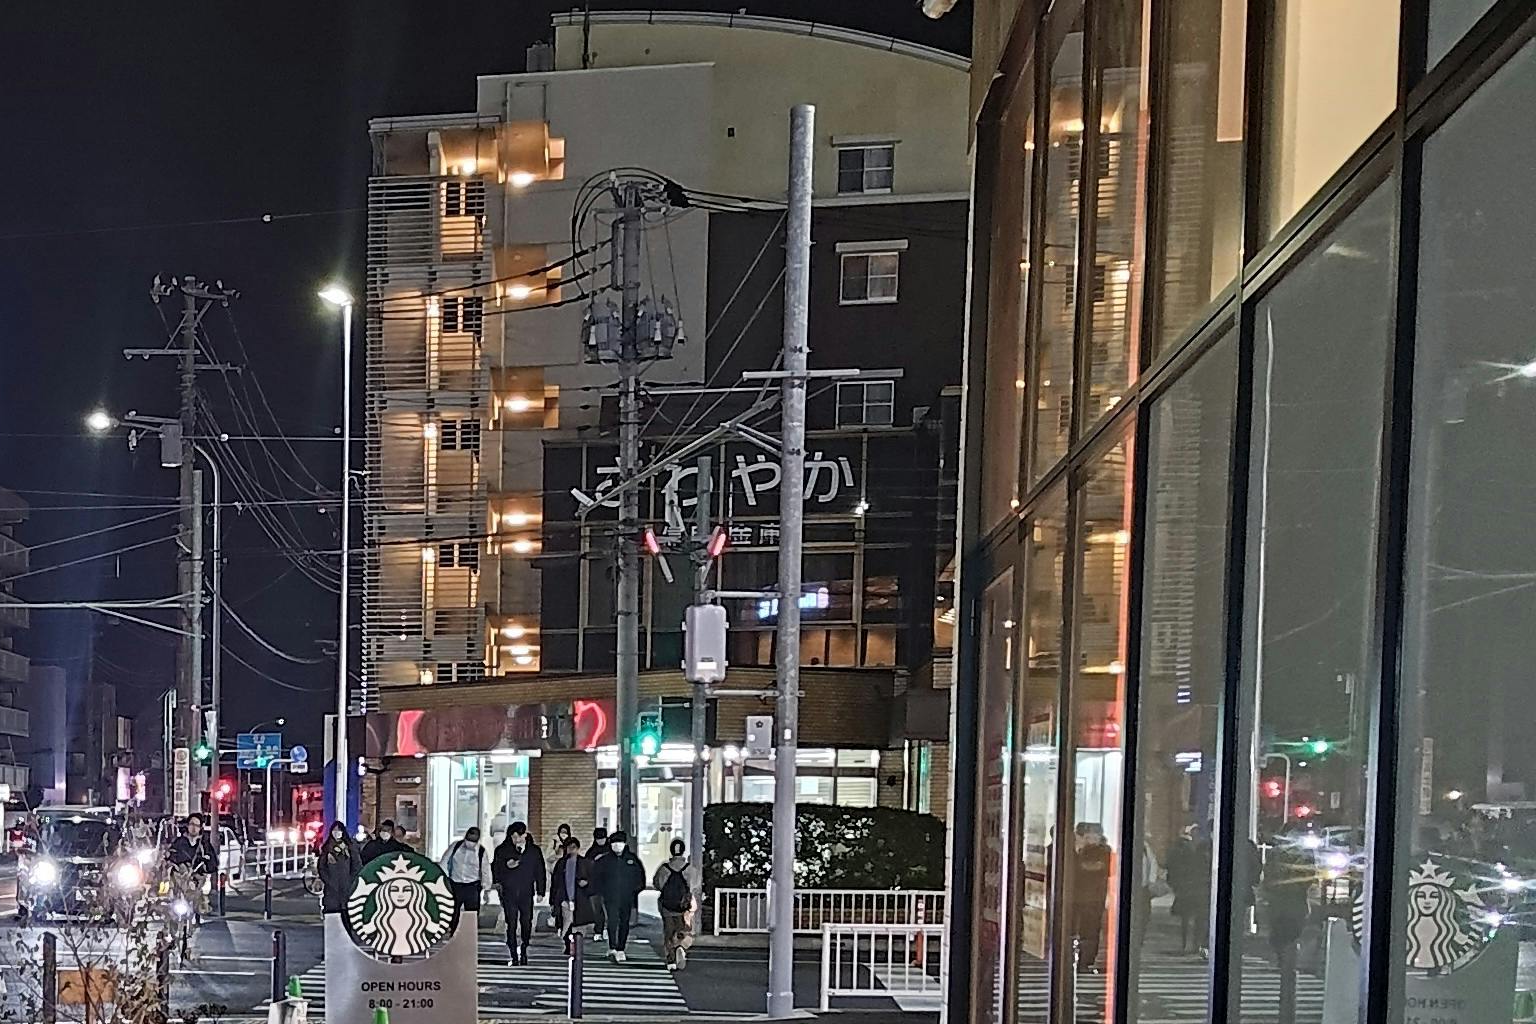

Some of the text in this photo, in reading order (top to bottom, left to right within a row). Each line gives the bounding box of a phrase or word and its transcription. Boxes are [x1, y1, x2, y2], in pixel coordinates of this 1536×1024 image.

[663, 522, 781, 546] 信金庫
[360, 980, 442, 992] OPEN HOURS
[368, 998, 393, 1009] 8:00
[402, 998, 434, 1009] 21:00
